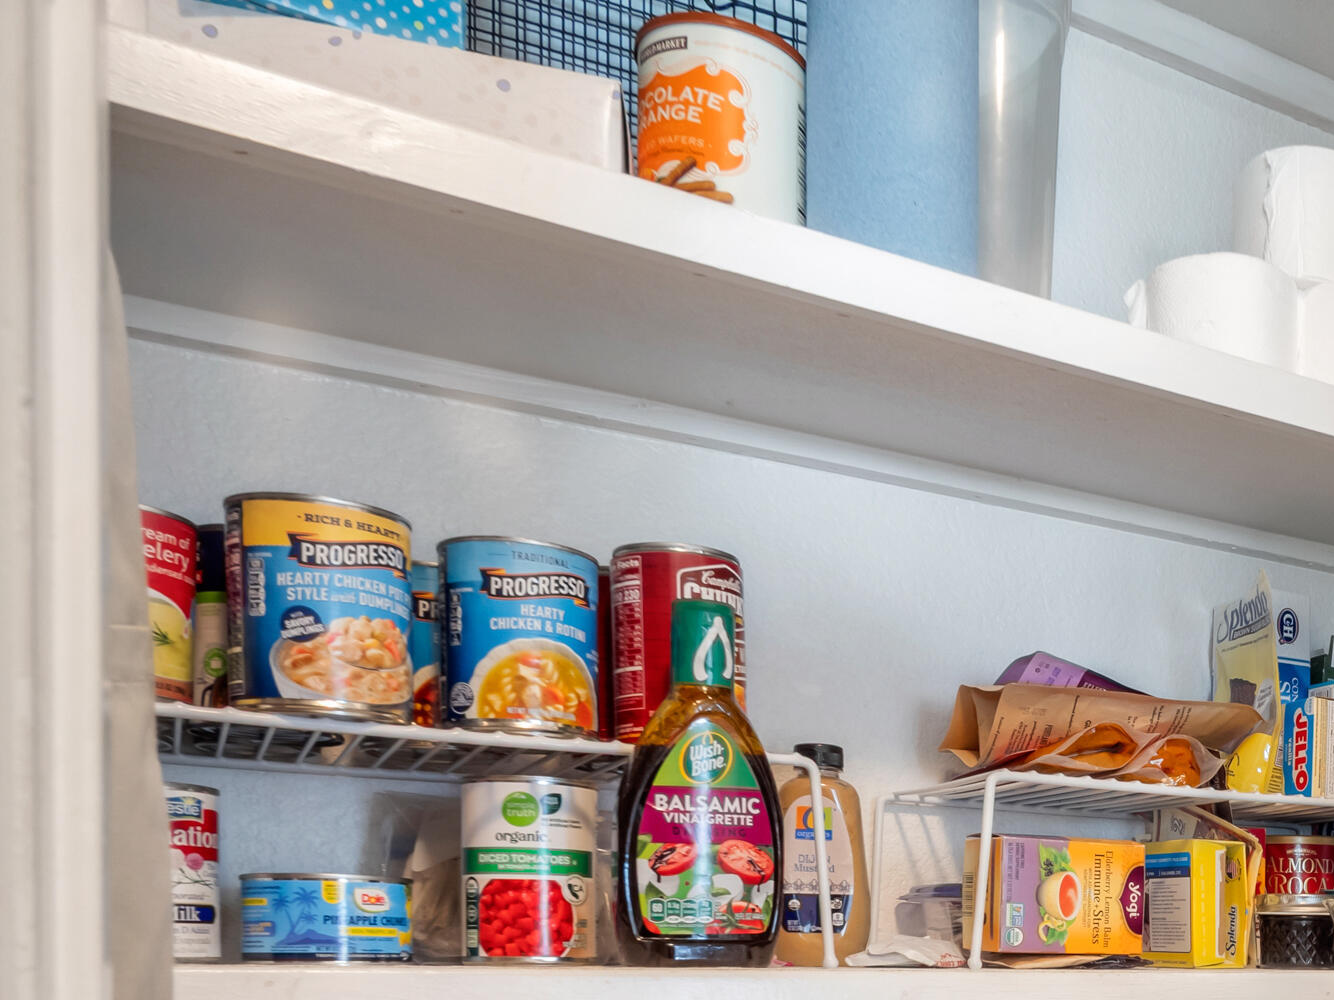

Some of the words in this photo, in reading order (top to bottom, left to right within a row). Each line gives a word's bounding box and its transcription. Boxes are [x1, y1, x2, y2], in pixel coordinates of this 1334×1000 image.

[641, 85, 725, 112] COLATE
[641, 103, 703, 128] ANGE
[304, 513, 341, 526] RICH
[344, 519, 353, 528] &
[356, 521, 402, 541] HEARTY
[143, 542, 189, 573] elery
[301, 542, 404, 569] PROGRESSO
[511, 550, 570, 570] TRADITIONAL
[276, 571, 330, 586] HEARTY
[334, 573, 387, 596] CHICKEN
[286, 587, 329, 601] STYLE
[490, 576, 585, 599] PROGRESSO
[521, 604, 565, 621] HEARTY
[489, 617, 542, 631] CHICKEN
[545, 621, 553, 633] &
[654, 794, 761, 816] BALSAMIC
[169, 826, 218, 849] ation
[477, 852, 510, 864] DICED
[511, 852, 570, 866] TOMATOES
[794, 863, 835, 873] Mustd
[1267, 856, 1334, 876] ALMOND
[1093, 853, 1105, 903] Immune
[1103, 850, 1113, 894] Elderberry
[1268, 873, 1328, 894] ROCA
[1103, 896, 1113, 924] Lemon
[1126, 881, 1141, 918] yogi
[1091, 910, 1104, 945] Stress
[1103, 926, 1112, 948] Balm
[1226, 905, 1237, 957] Splenda
